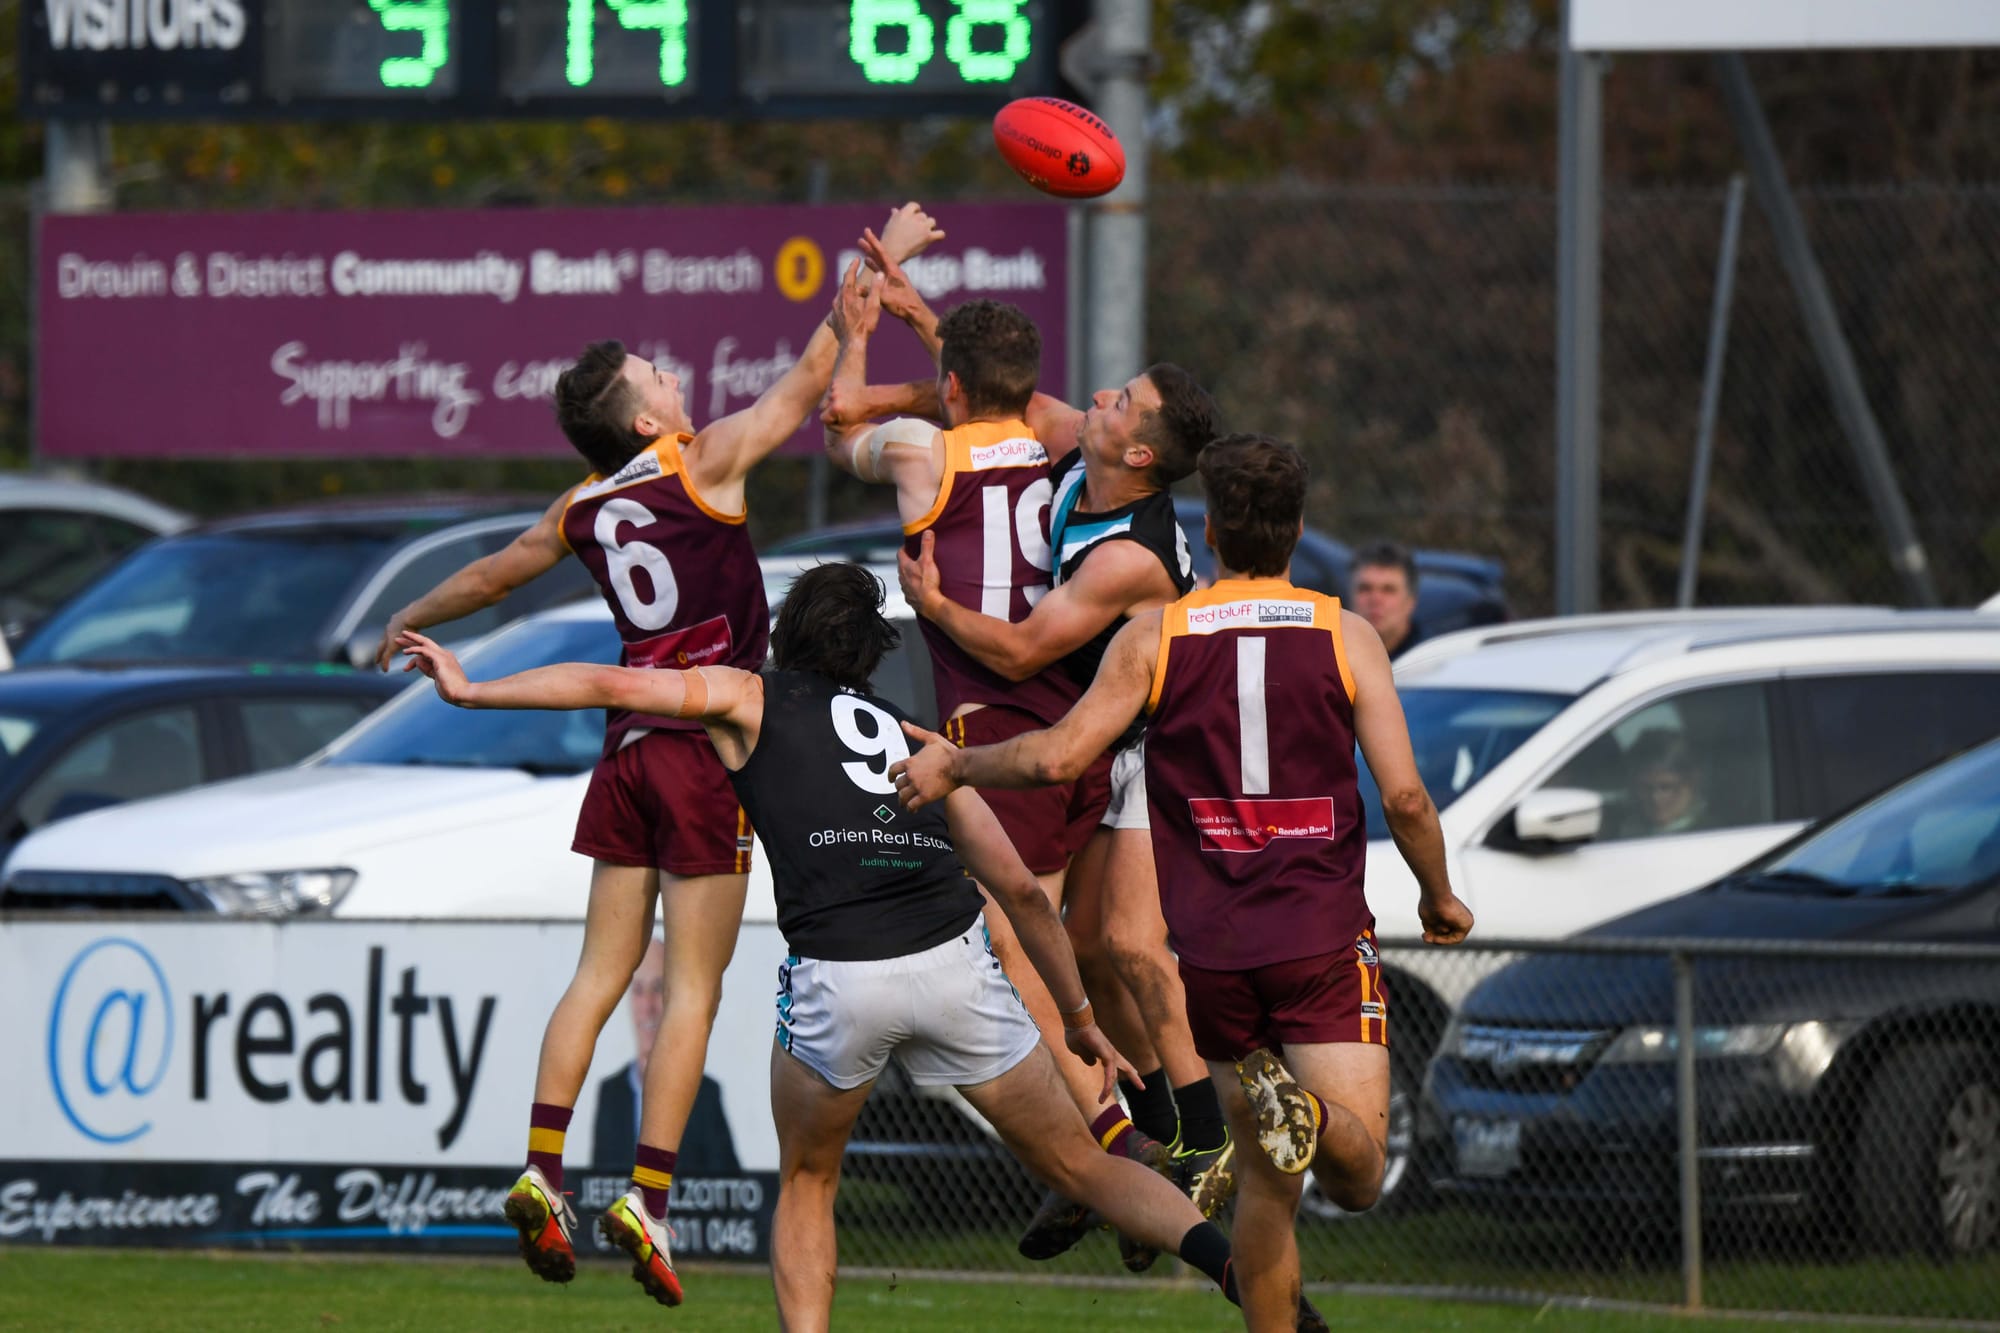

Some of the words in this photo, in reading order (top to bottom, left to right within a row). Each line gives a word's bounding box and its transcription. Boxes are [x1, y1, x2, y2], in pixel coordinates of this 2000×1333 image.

[46, 0, 247, 49] VISITORS
[849, 0, 1031, 84] 68
[58, 251, 167, 299] Drouin
[171, 250, 201, 298] &
[207, 251, 326, 298] District
[331, 250, 523, 303] Community
[643, 248, 763, 294] Branch
[961, 248, 1045, 291] Bank
[270, 340, 482, 438] Supporting
[594, 498, 679, 631] 6
[1190, 610, 1215, 623] red
[1219, 604, 1253, 620] bluff
[1258, 603, 1313, 617] homes
[831, 694, 910, 794] 9
[1237, 636, 1270, 794] 1
[809, 828, 868, 847] OBrien
[871, 829, 909, 845] Real
[1278, 827, 1308, 836] Bendigo
[1309, 825, 1329, 835] Bank
[859, 857, 889, 867] Judith
[891, 859, 922, 870] Wright
[0, 1179, 219, 1241] Experience
[236, 1171, 320, 1224] The
